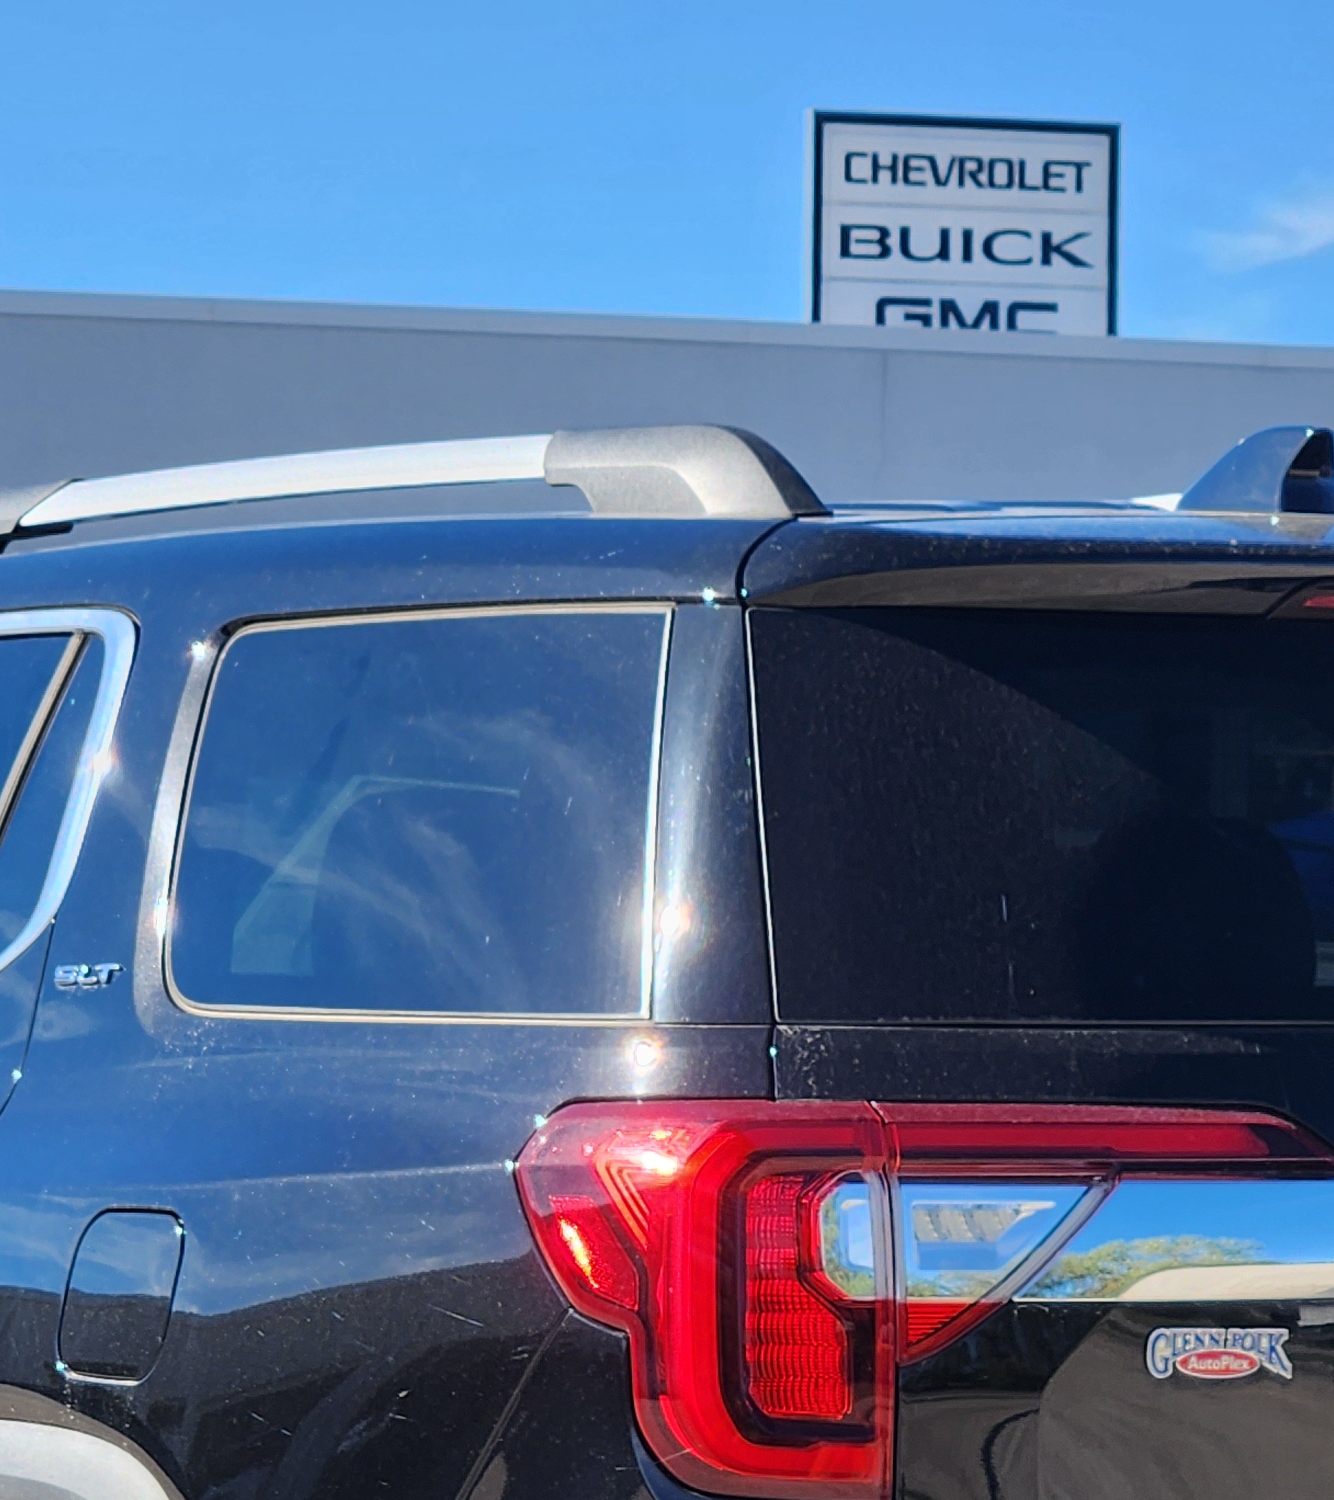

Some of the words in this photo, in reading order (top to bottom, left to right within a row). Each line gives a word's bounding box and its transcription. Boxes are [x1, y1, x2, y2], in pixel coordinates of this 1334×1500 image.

[844, 151, 1092, 193] CHEVROLET
[839, 223, 1094, 269] BUICK
[875, 296, 1059, 335] GMC
[54, 962, 126, 991] SLT
[1148, 1329, 1223, 1376] GLENN
[1230, 1329, 1290, 1375] POLK
[1185, 1354, 1251, 1371] AutoPlex
